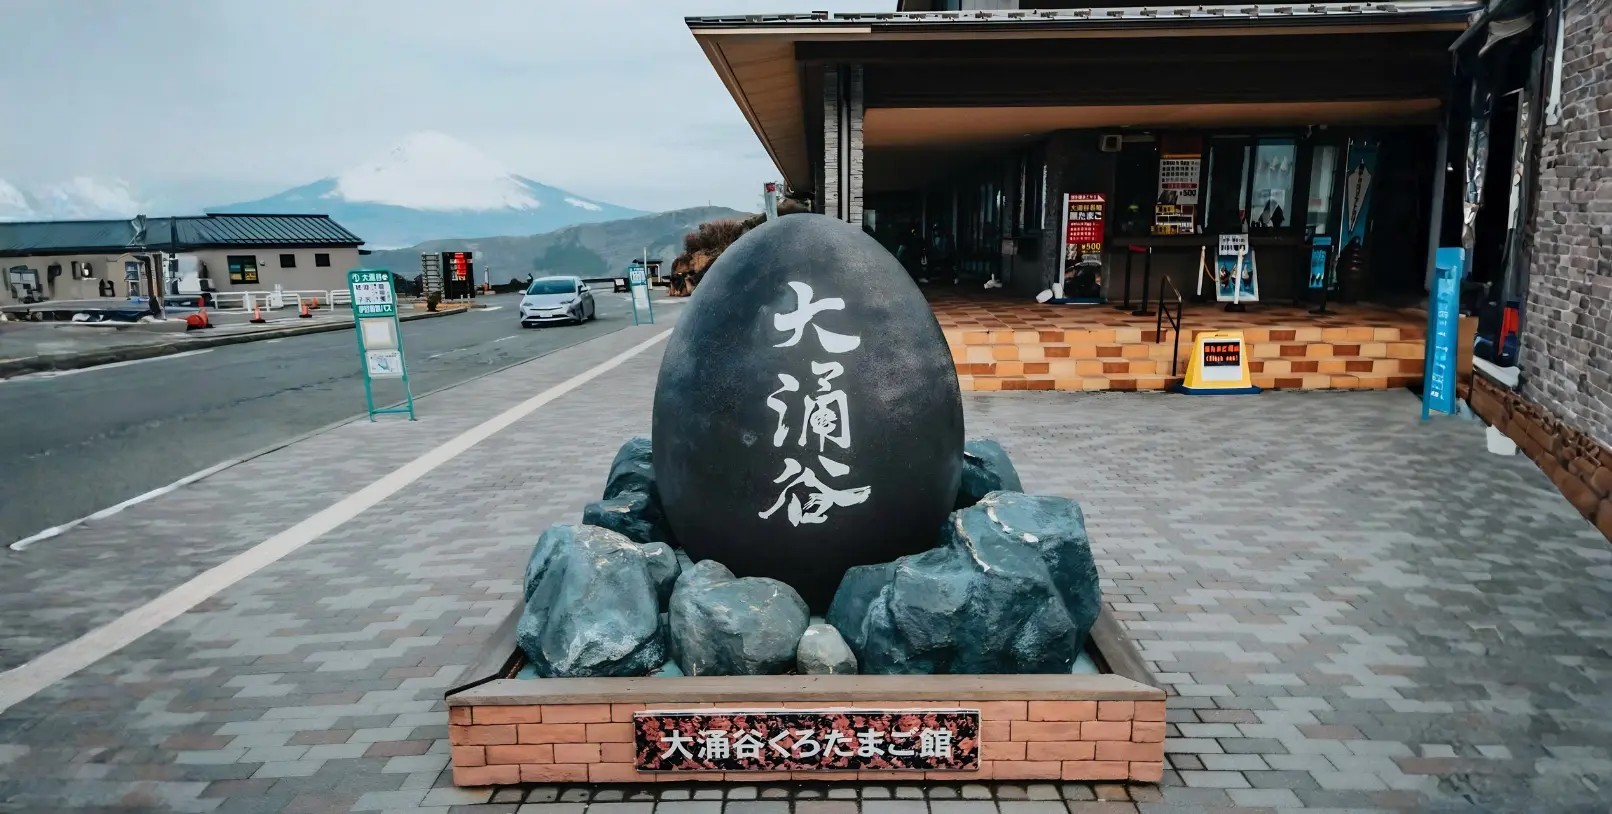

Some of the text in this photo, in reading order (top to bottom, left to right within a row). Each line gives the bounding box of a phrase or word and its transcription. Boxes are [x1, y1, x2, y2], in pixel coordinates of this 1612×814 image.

[758, 281, 871, 527] 大涌谷
[660, 727, 952, 761] 大涌谷くろたまご館
